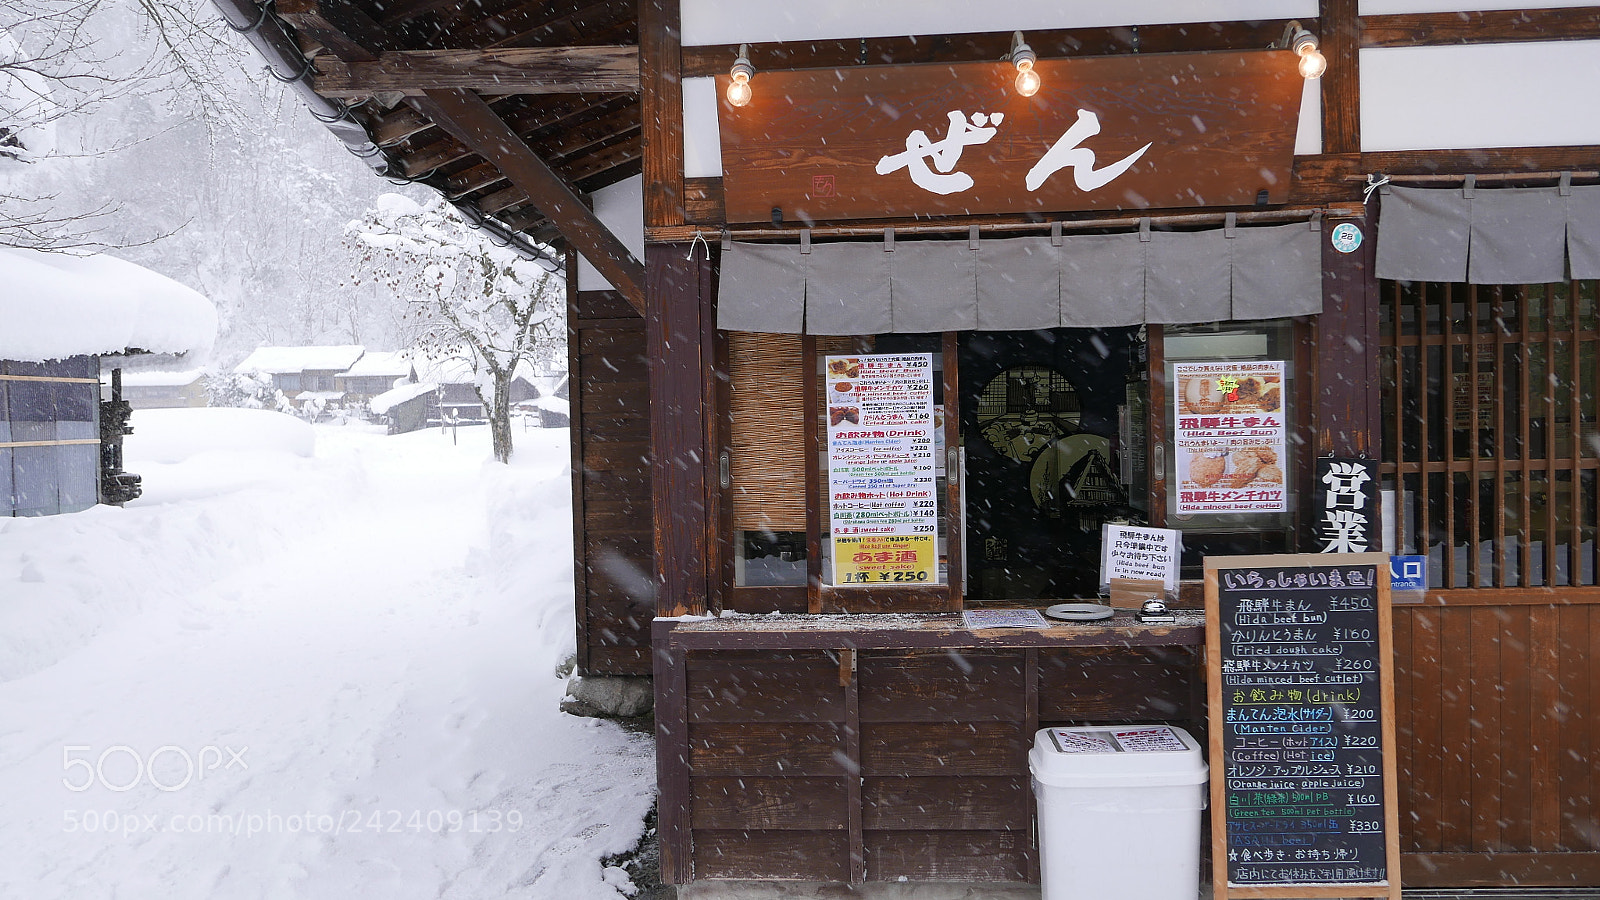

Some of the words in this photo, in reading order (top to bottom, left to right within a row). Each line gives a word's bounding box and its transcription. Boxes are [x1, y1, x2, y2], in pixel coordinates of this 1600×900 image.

[876, 109, 1152, 194] ぜん
[1341, 232, 1354, 241] 28
[1179, 416, 1281, 428] 飛騨牛まん
[1182, 429, 1212, 437] (Hida
[1180, 490, 1282, 502] 飛騨牛メンチカツ
[1319, 462, 1371, 553] 営業
[913, 524, 934, 532] ¥250
[1119, 530, 1165, 542] 飛騨牛まんは
[1115, 540, 1168, 552] 只今準備中です
[853, 550, 917, 562] あま酒
[846, 572, 870, 582] 1杯
[880, 570, 928, 581] ¥250
[1224, 568, 1375, 588] いらっしゃいませ!
[1236, 598, 1312, 612] 飛騨牛まん
[1329, 595, 1371, 610] ¥450
[1234, 612, 1267, 625] (Hida
[1274, 613, 1296, 623] beef
[1303, 611, 1328, 624] bun)
[1231, 628, 1317, 641] かりんとうまん
[1333, 627, 1371, 640] ¥160
[1232, 644, 1270, 656] (Fried
[1276, 645, 1308, 656] dough
[1312, 644, 1343, 655] cake)
[1222, 659, 1314, 672] 飛騨牛メンチカツ
[1335, 659, 1373, 671] ¥260
[1226, 674, 1256, 686] (Hida
[1257, 675, 1294, 684] minced
[1299, 674, 1320, 684] beef
[1325, 673, 1363, 685] cutlet)
[1343, 707, 1374, 719] ¥200
[1234, 724, 1287, 734] (Manten
[1292, 723, 1333, 733] Cider)
[1343, 735, 1376, 746] ¥220
[1231, 750, 1280, 762] (Coffee)
[1346, 764, 1376, 774] ¥210
[1228, 779, 1267, 790] (Orange
[1331, 778, 1364, 788] juice)
[1347, 794, 1375, 804] ¥160
[1350, 819, 1379, 831] ¥330
